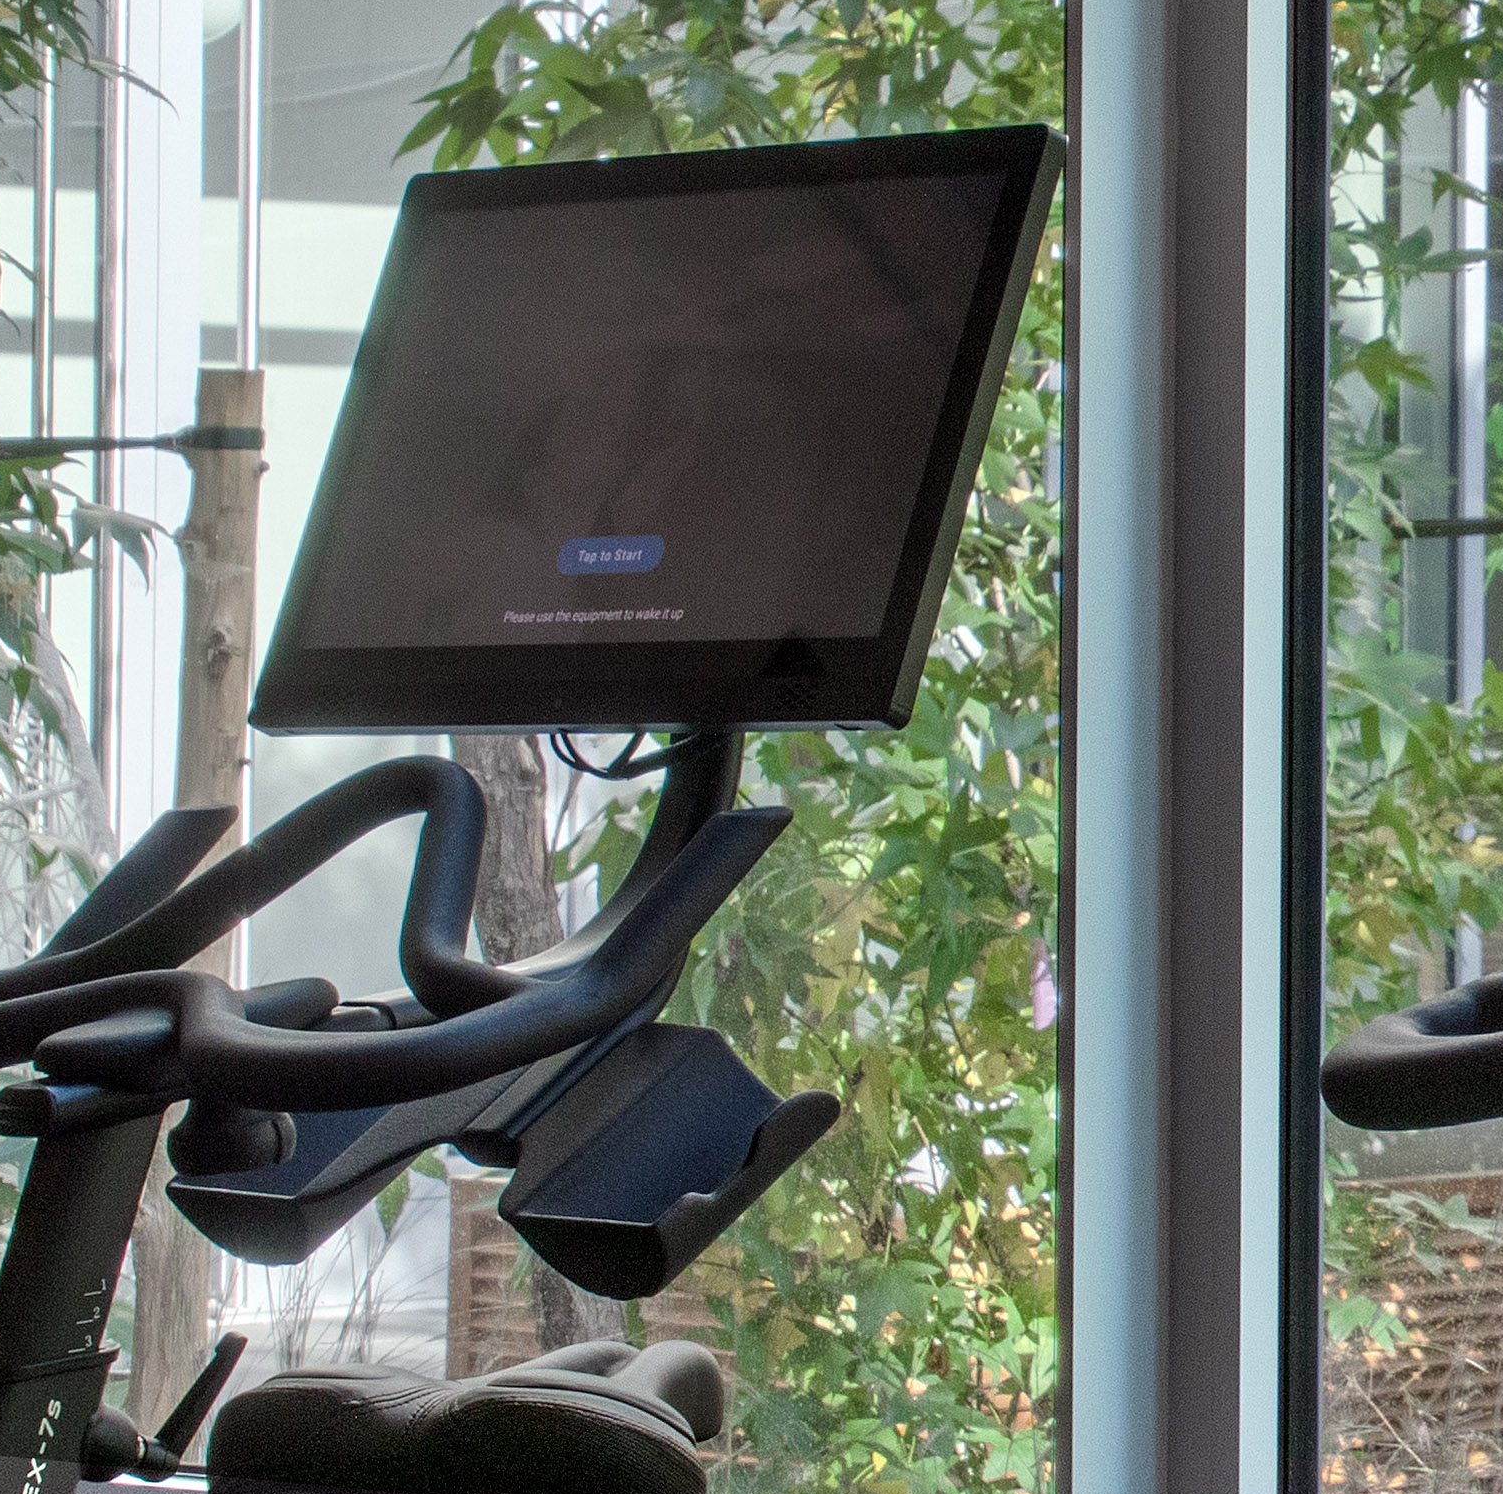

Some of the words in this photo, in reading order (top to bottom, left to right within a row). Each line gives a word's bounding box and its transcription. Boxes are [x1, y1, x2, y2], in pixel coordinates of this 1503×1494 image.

[578, 549, 597, 564] Tap
[600, 549, 611, 562] to
[614, 547, 643, 561] Start
[503, 610, 535, 623] Please
[536, 612, 554, 622] use
[555, 610, 572, 622] the
[572, 609, 623, 623] equipment
[624, 609, 634, 621] to
[636, 609, 661, 621] wake
[662, 608, 670, 620] it
[671, 609, 684, 622] up
[101, 1278, 107, 1291] 1
[93, 1306, 101, 1319] 2
[84, 1334, 93, 1347] 3
